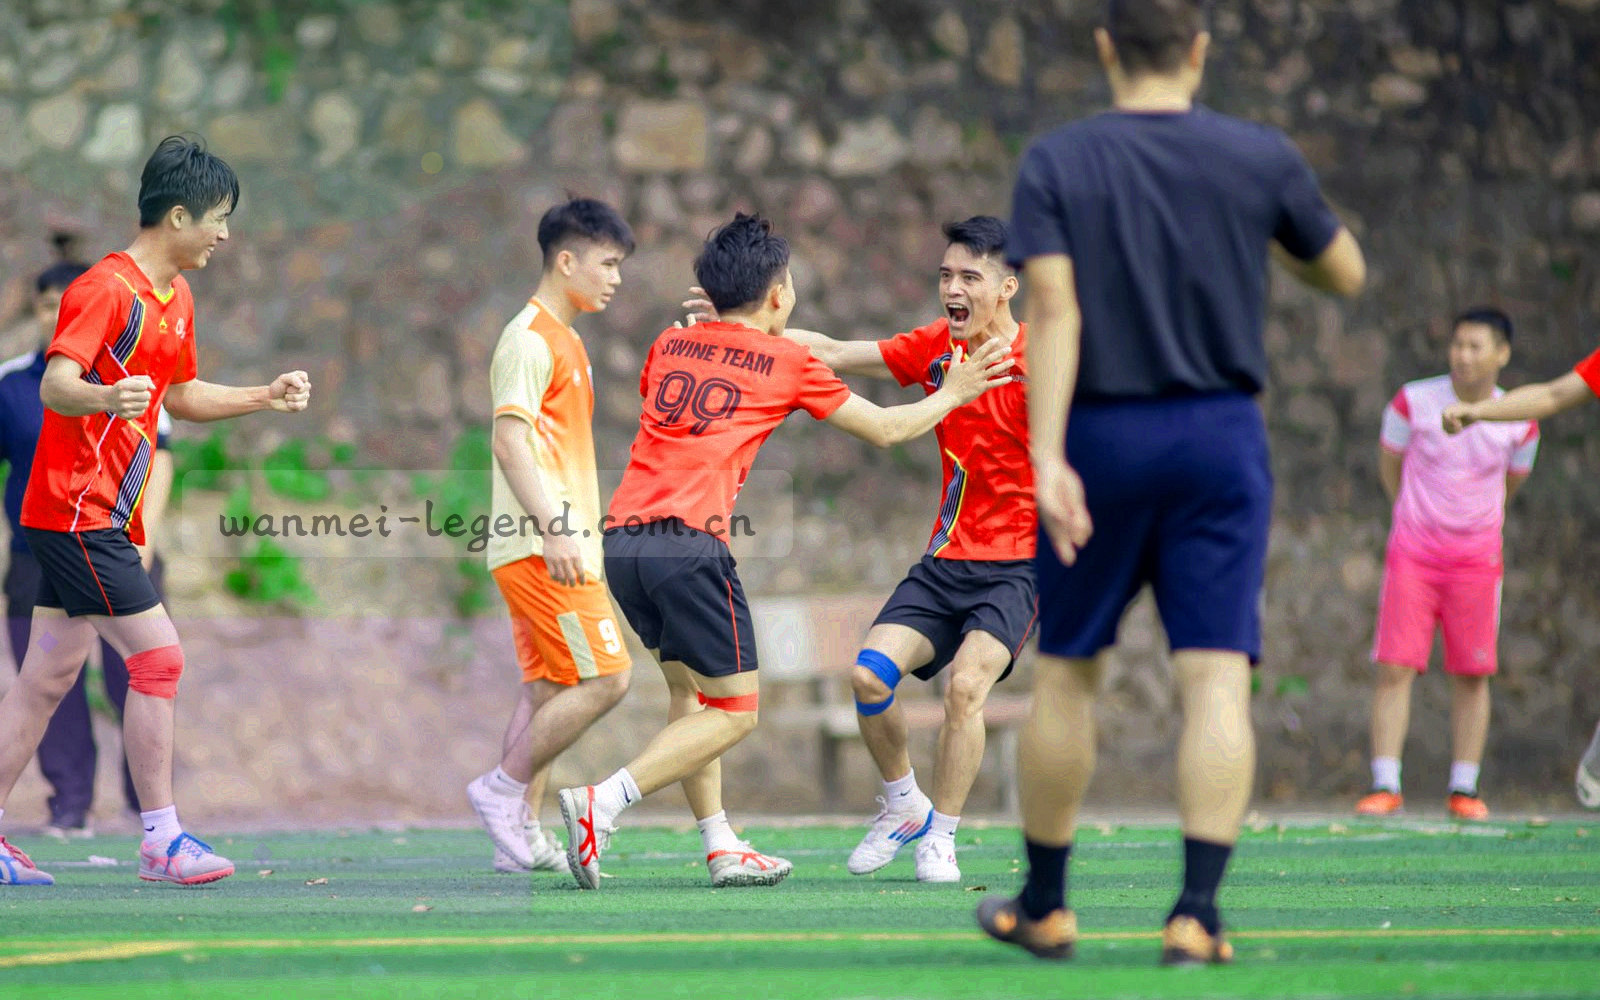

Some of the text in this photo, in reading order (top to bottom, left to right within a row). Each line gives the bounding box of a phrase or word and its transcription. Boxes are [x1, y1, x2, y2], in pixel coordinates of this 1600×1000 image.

[662, 339, 775, 376] SWINE TEAM
[655, 370, 741, 435] 99
[598, 618, 621, 654] 9
